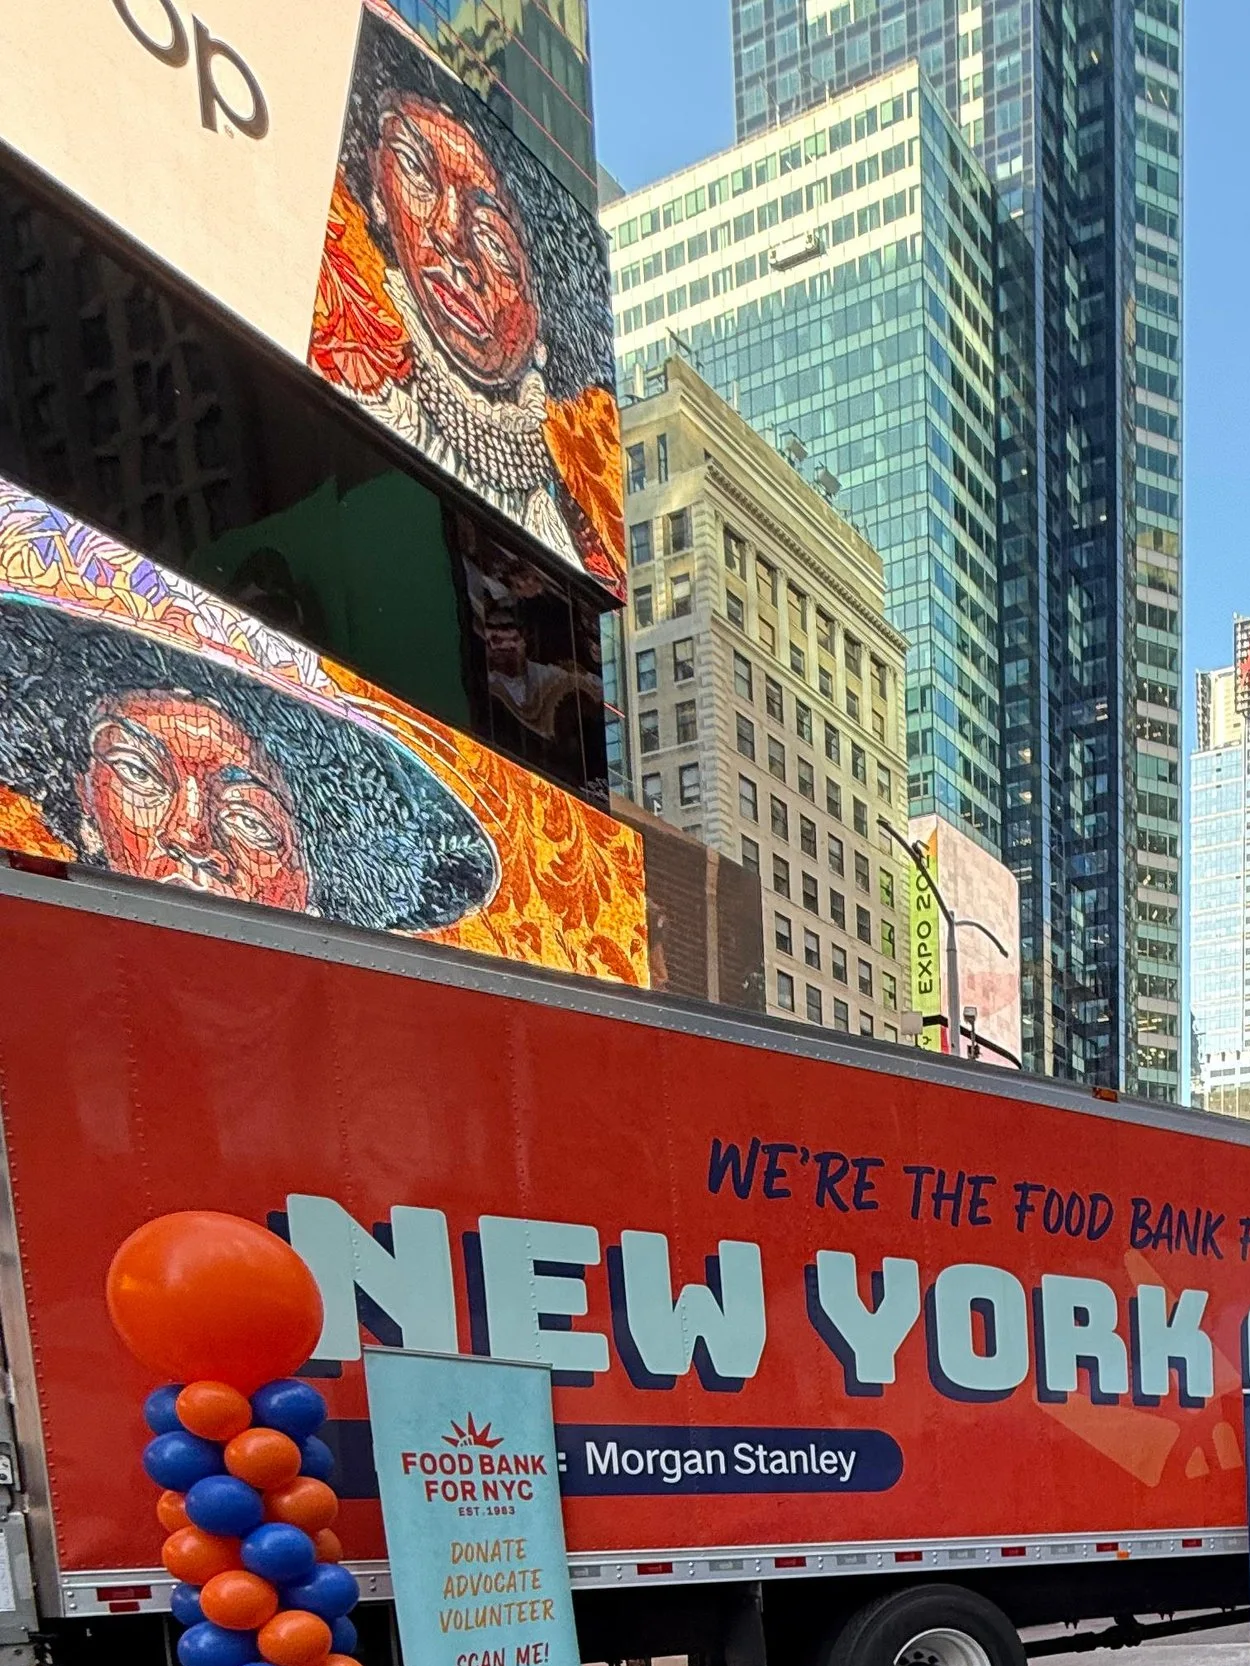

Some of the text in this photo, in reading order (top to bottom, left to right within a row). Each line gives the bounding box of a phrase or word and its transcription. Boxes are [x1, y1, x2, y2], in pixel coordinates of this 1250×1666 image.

[916, 920, 933, 994] EXPO
[708, 1138, 885, 1213] WE'RE
[903, 1165, 997, 1228] THE
[1013, 1181, 1115, 1241] FOOD
[1130, 1199, 1225, 1259] BANK
[284, 1193, 767, 1380] NEW
[813, 1249, 1214, 1398] YORK
[401, 1452, 474, 1475] FOOD
[478, 1454, 547, 1475] BANK
[585, 1441, 727, 1482] Morgan
[734, 1442, 856, 1483] Stanley
[424, 1479, 534, 1502] FOR NYC
[451, 1538, 528, 1564] DONATE
[444, 1568, 544, 1600] ADVOCATE
[439, 1599, 555, 1633] VOLUNTEER
